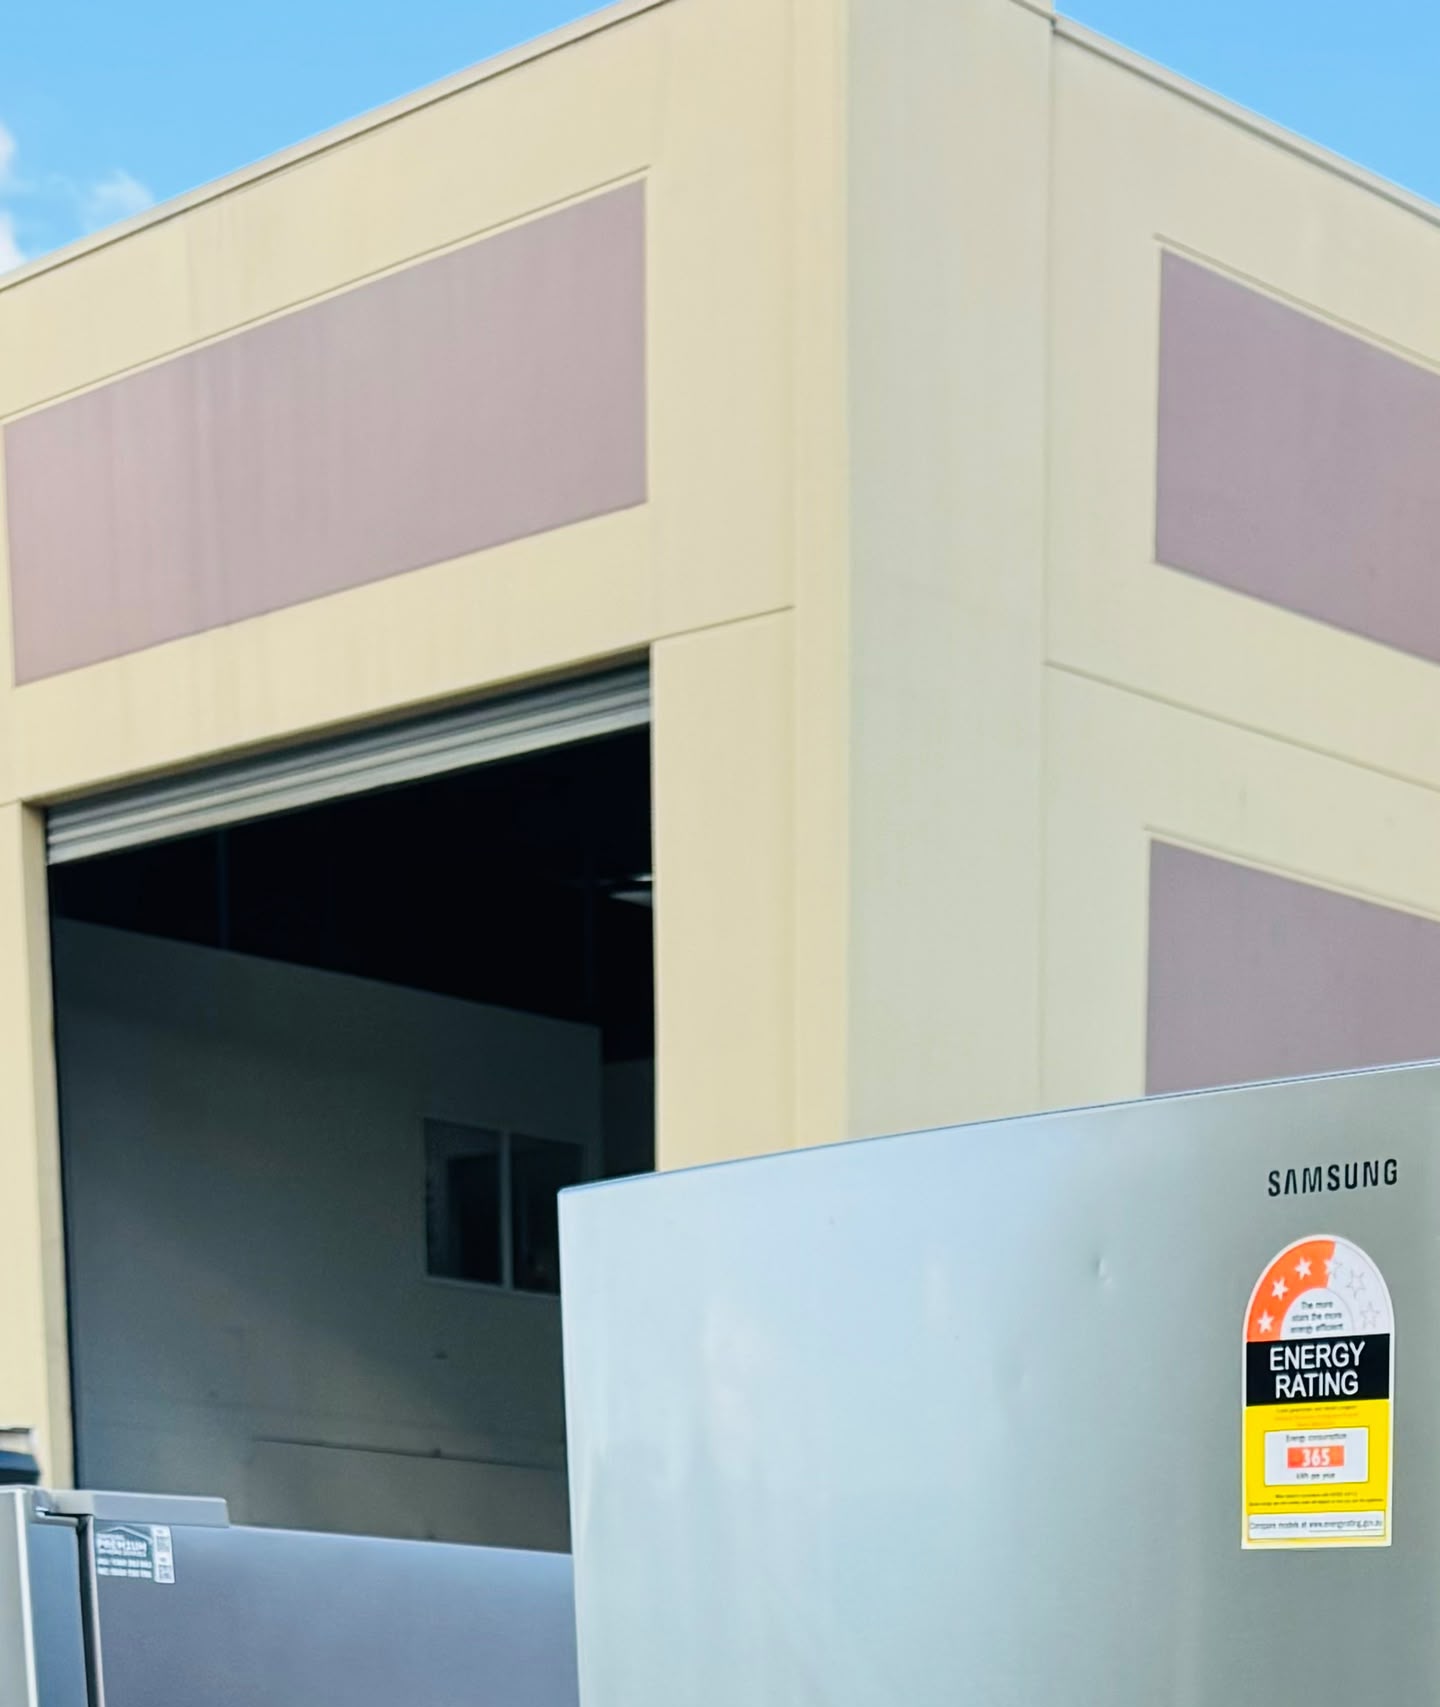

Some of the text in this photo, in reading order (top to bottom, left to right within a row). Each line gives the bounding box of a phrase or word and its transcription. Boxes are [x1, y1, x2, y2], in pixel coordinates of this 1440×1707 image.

[1268, 1158, 1398, 1197] SAMSUNG
[1269, 1340, 1366, 1371] ENERGY
[1275, 1369, 1359, 1399] RATING
[1302, 1447, 1331, 1467] 365
